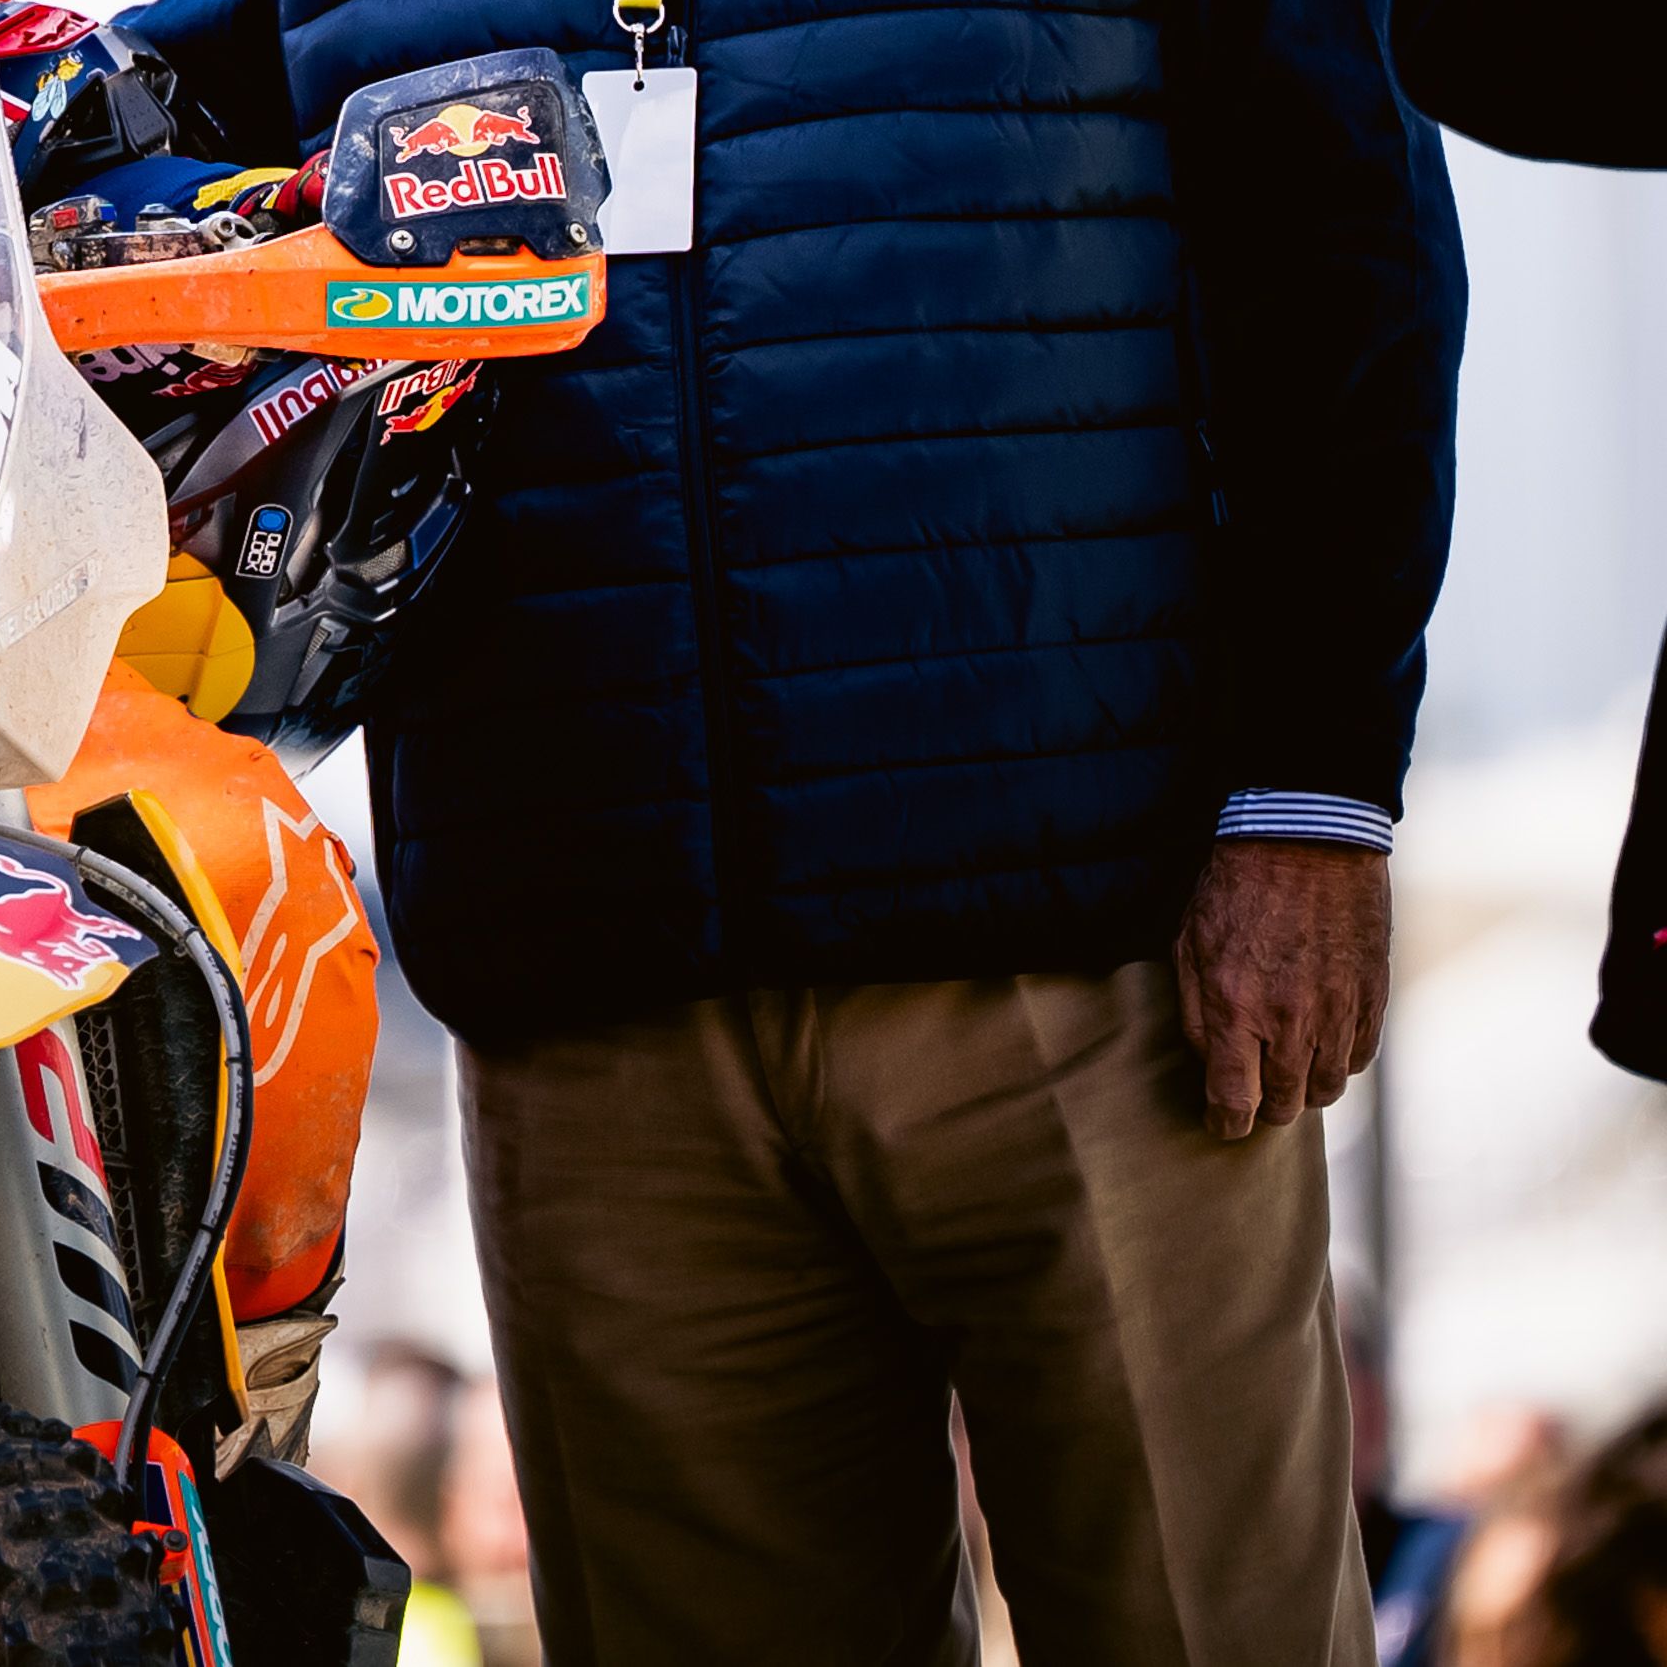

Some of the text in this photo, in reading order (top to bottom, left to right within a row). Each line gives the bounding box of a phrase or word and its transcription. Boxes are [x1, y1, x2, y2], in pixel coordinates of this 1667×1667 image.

[385, 153, 566, 219] Red Bull
[397, 278, 585, 322] MOTOREX
[245, 531, 267, 572] LOCK
[260, 534, 282, 574] QUAD
